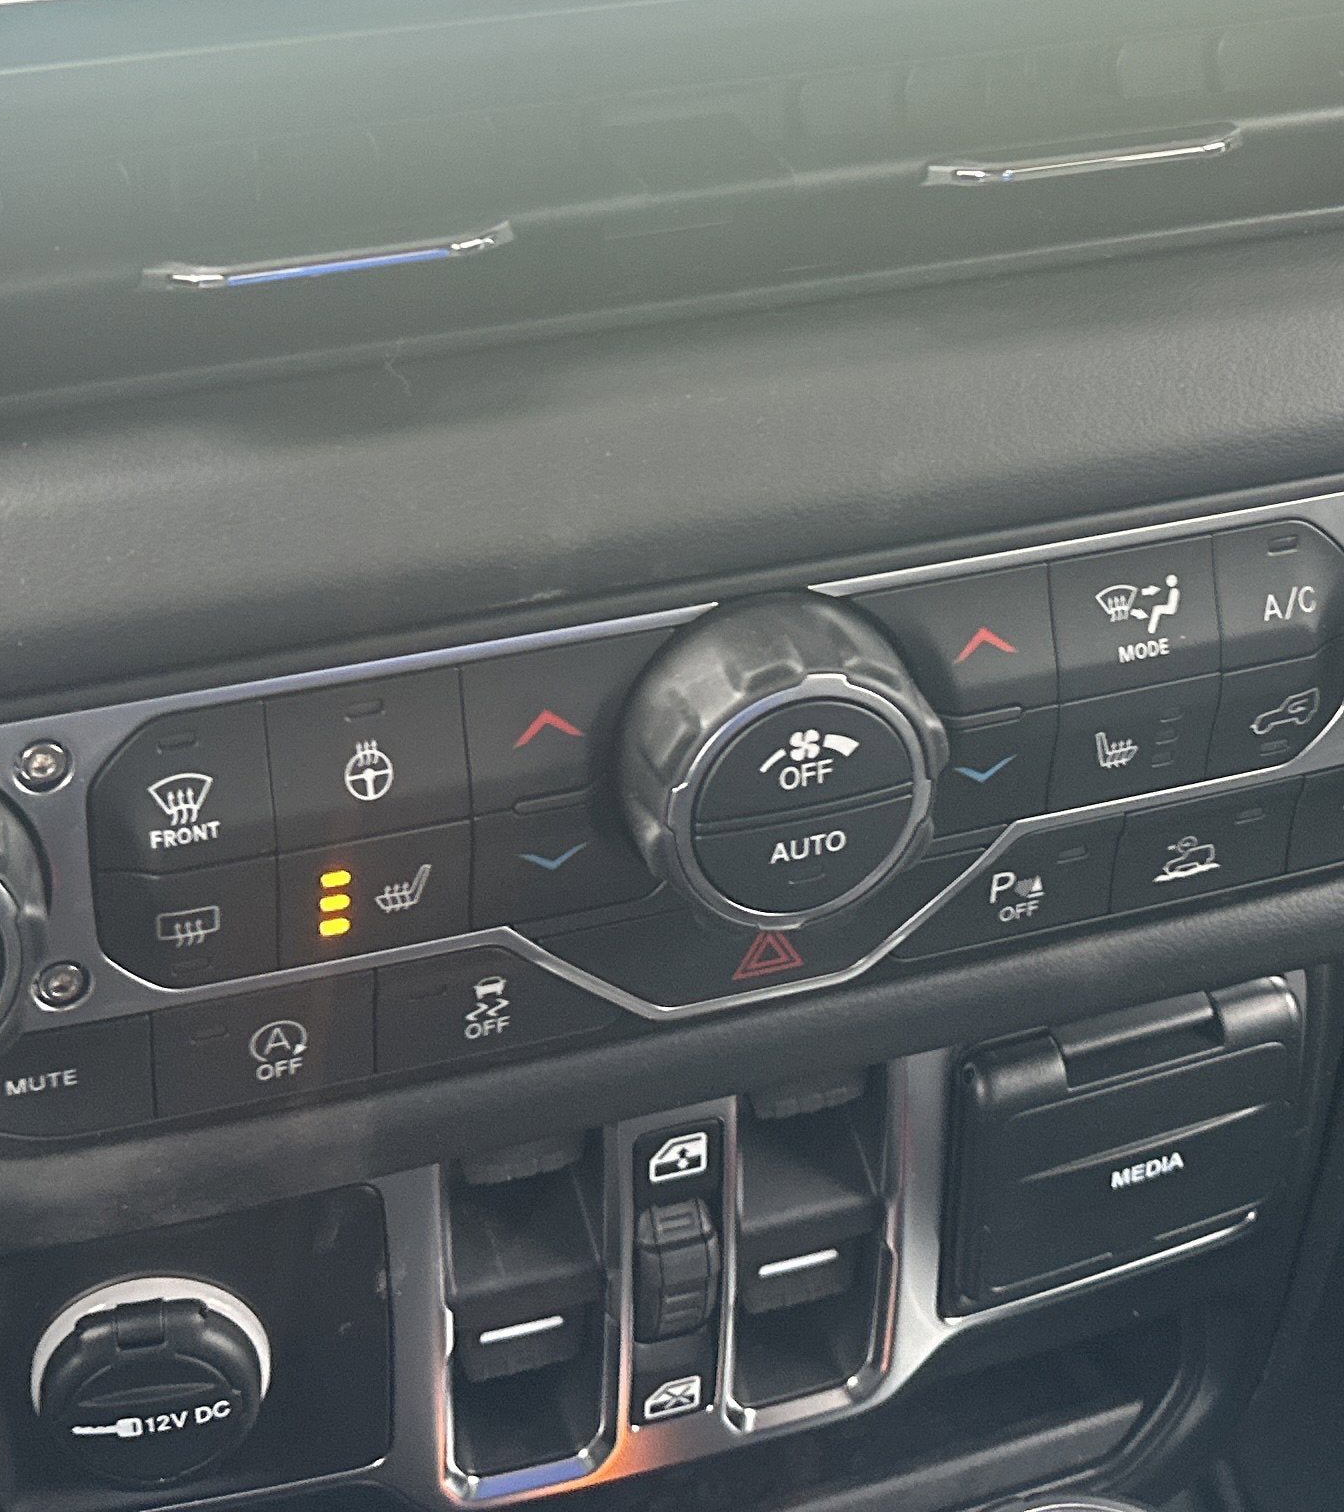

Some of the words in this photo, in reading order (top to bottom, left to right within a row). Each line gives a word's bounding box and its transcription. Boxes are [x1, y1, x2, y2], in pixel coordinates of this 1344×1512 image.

[1263, 585, 1316, 622] A/C
[1117, 637, 1170, 663] MODE
[779, 758, 833, 790] OFF
[149, 820, 221, 849] FRONT
[769, 830, 847, 864] AUTO
[998, 900, 1039, 922] OFF
[464, 1016, 510, 1039] OFF
[4, 1069, 78, 1096] MUTE
[256, 1057, 303, 1081] OFF
[1111, 1152, 1184, 1190] MEDIA
[145, 1410, 188, 1433] 12V
[194, 1400, 231, 1424] DC
